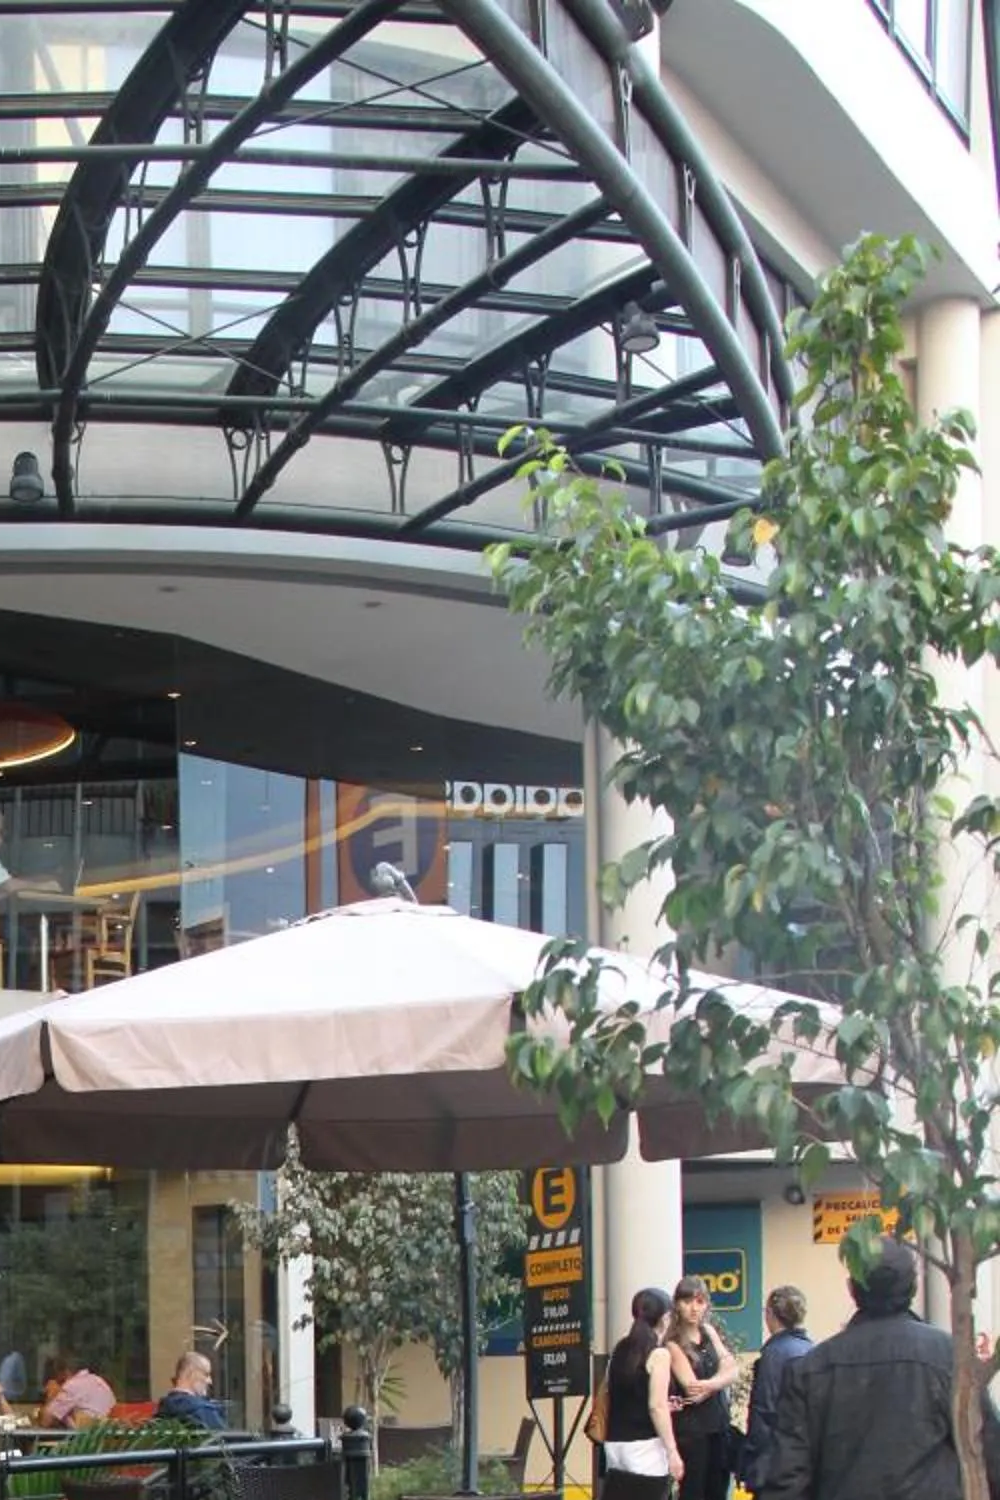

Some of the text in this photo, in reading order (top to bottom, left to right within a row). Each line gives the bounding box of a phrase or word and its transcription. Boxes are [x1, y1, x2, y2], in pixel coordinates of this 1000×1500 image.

[542, 1169, 566, 1217] E
[825, 1199, 881, 1212] PRECAUC
[529, 1257, 582, 1277] COMPLETO
